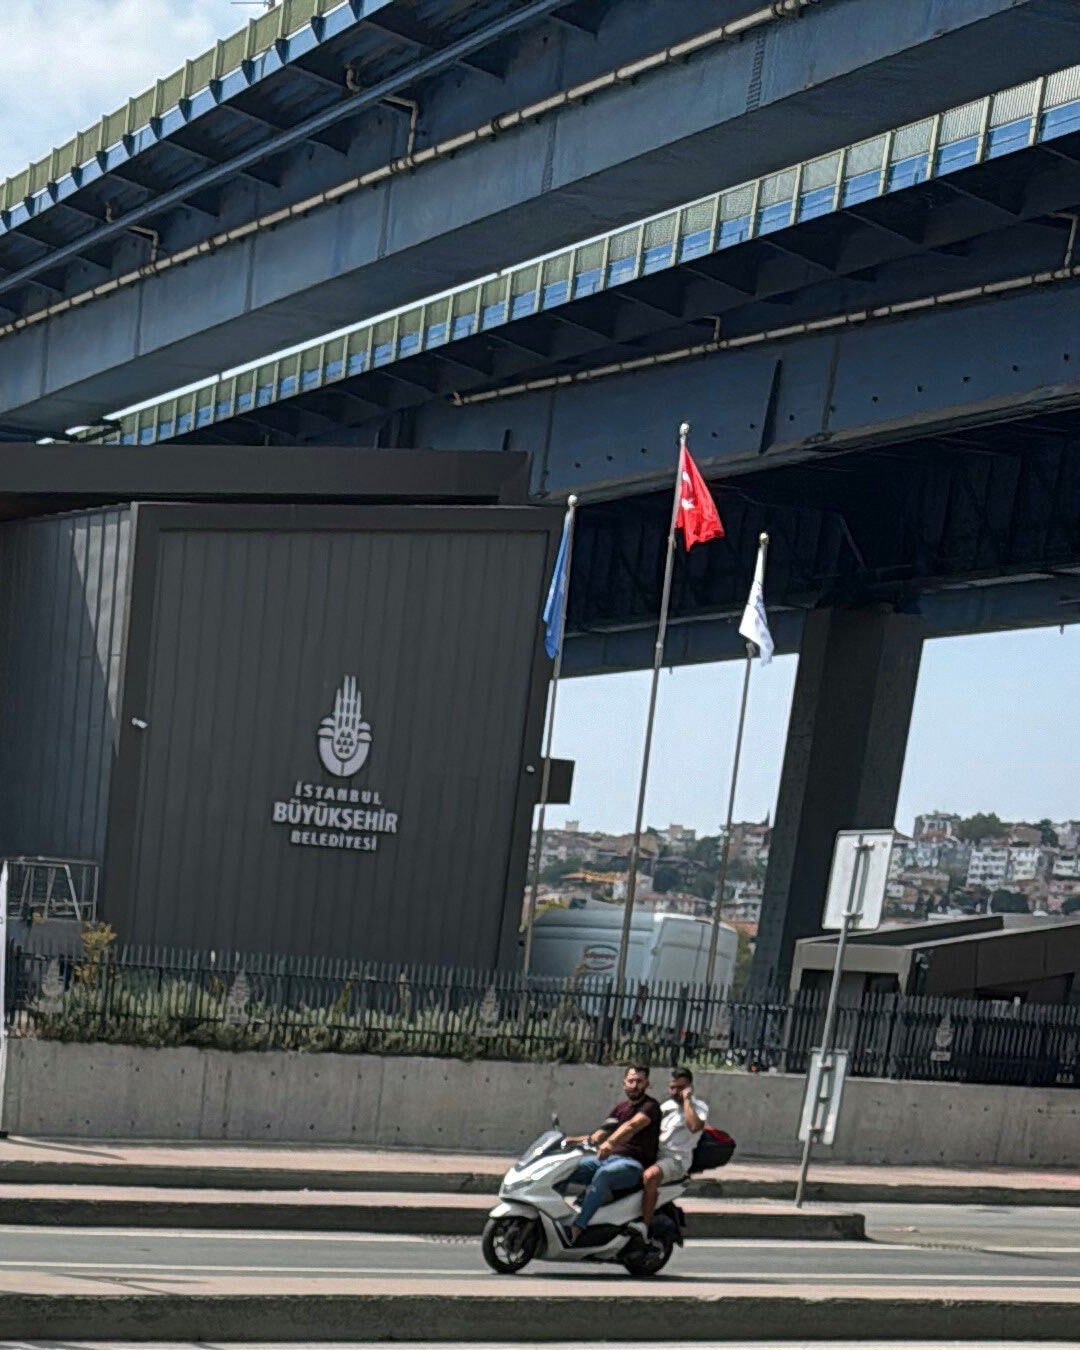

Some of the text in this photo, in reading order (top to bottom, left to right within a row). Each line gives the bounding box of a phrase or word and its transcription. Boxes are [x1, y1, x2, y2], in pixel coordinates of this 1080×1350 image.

[295, 780, 382, 805] İSTANBUL
[272, 798, 398, 833] BÜYÜKŞEHİR
[290, 830, 377, 851] BELEDİYESİ
